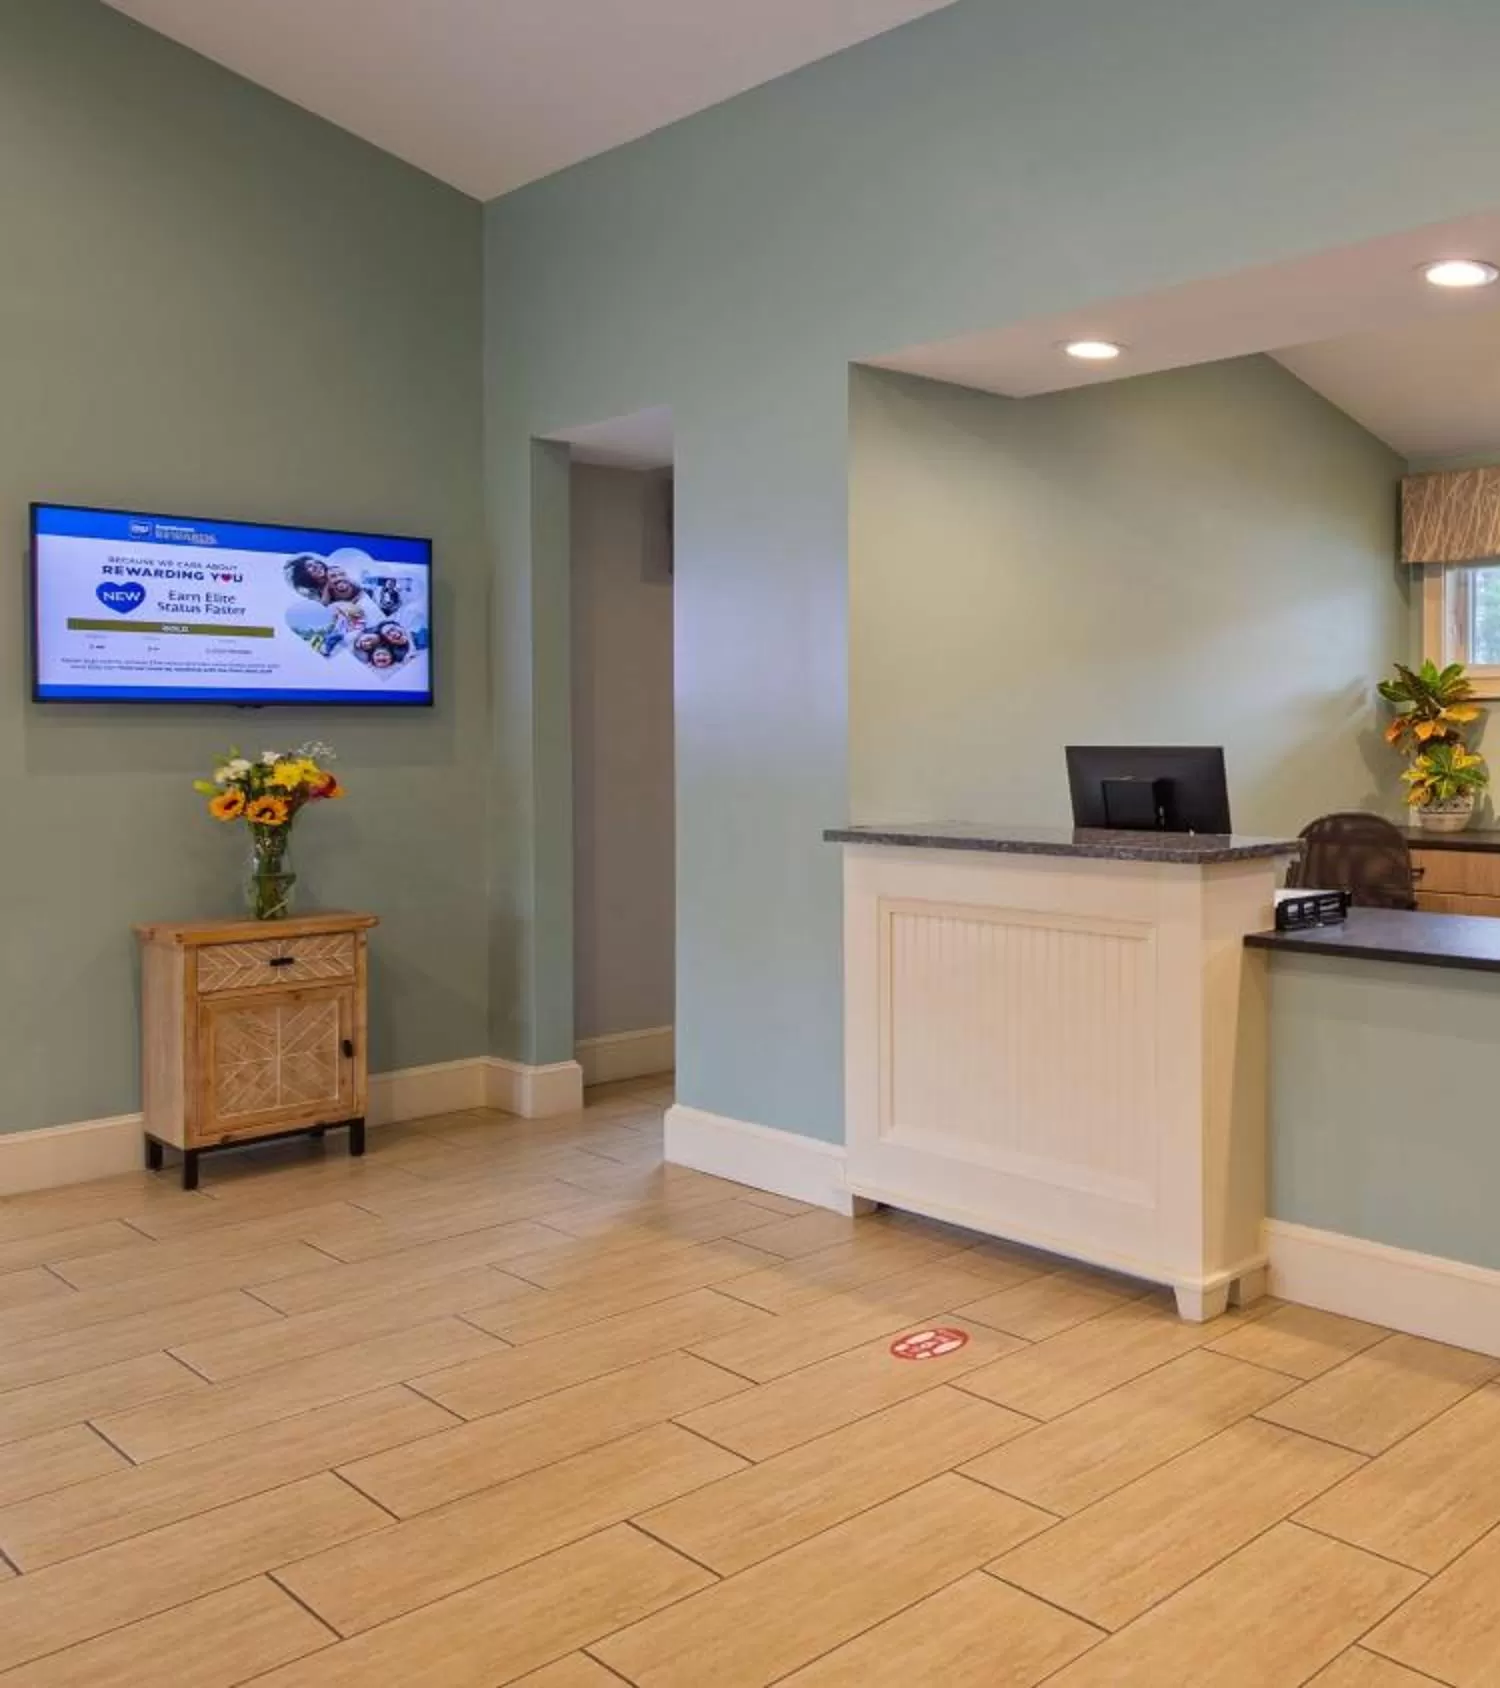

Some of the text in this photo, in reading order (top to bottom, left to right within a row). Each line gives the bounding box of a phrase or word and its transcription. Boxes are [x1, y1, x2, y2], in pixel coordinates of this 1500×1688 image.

[107, 556, 155, 567] BECAUSE
[205, 563, 238, 571] ABOUT
[101, 565, 205, 581] REWARDING
[102, 591, 141, 603] NEW
[168, 589, 237, 604] Earn Elite
[157, 601, 247, 616] Status Faster
